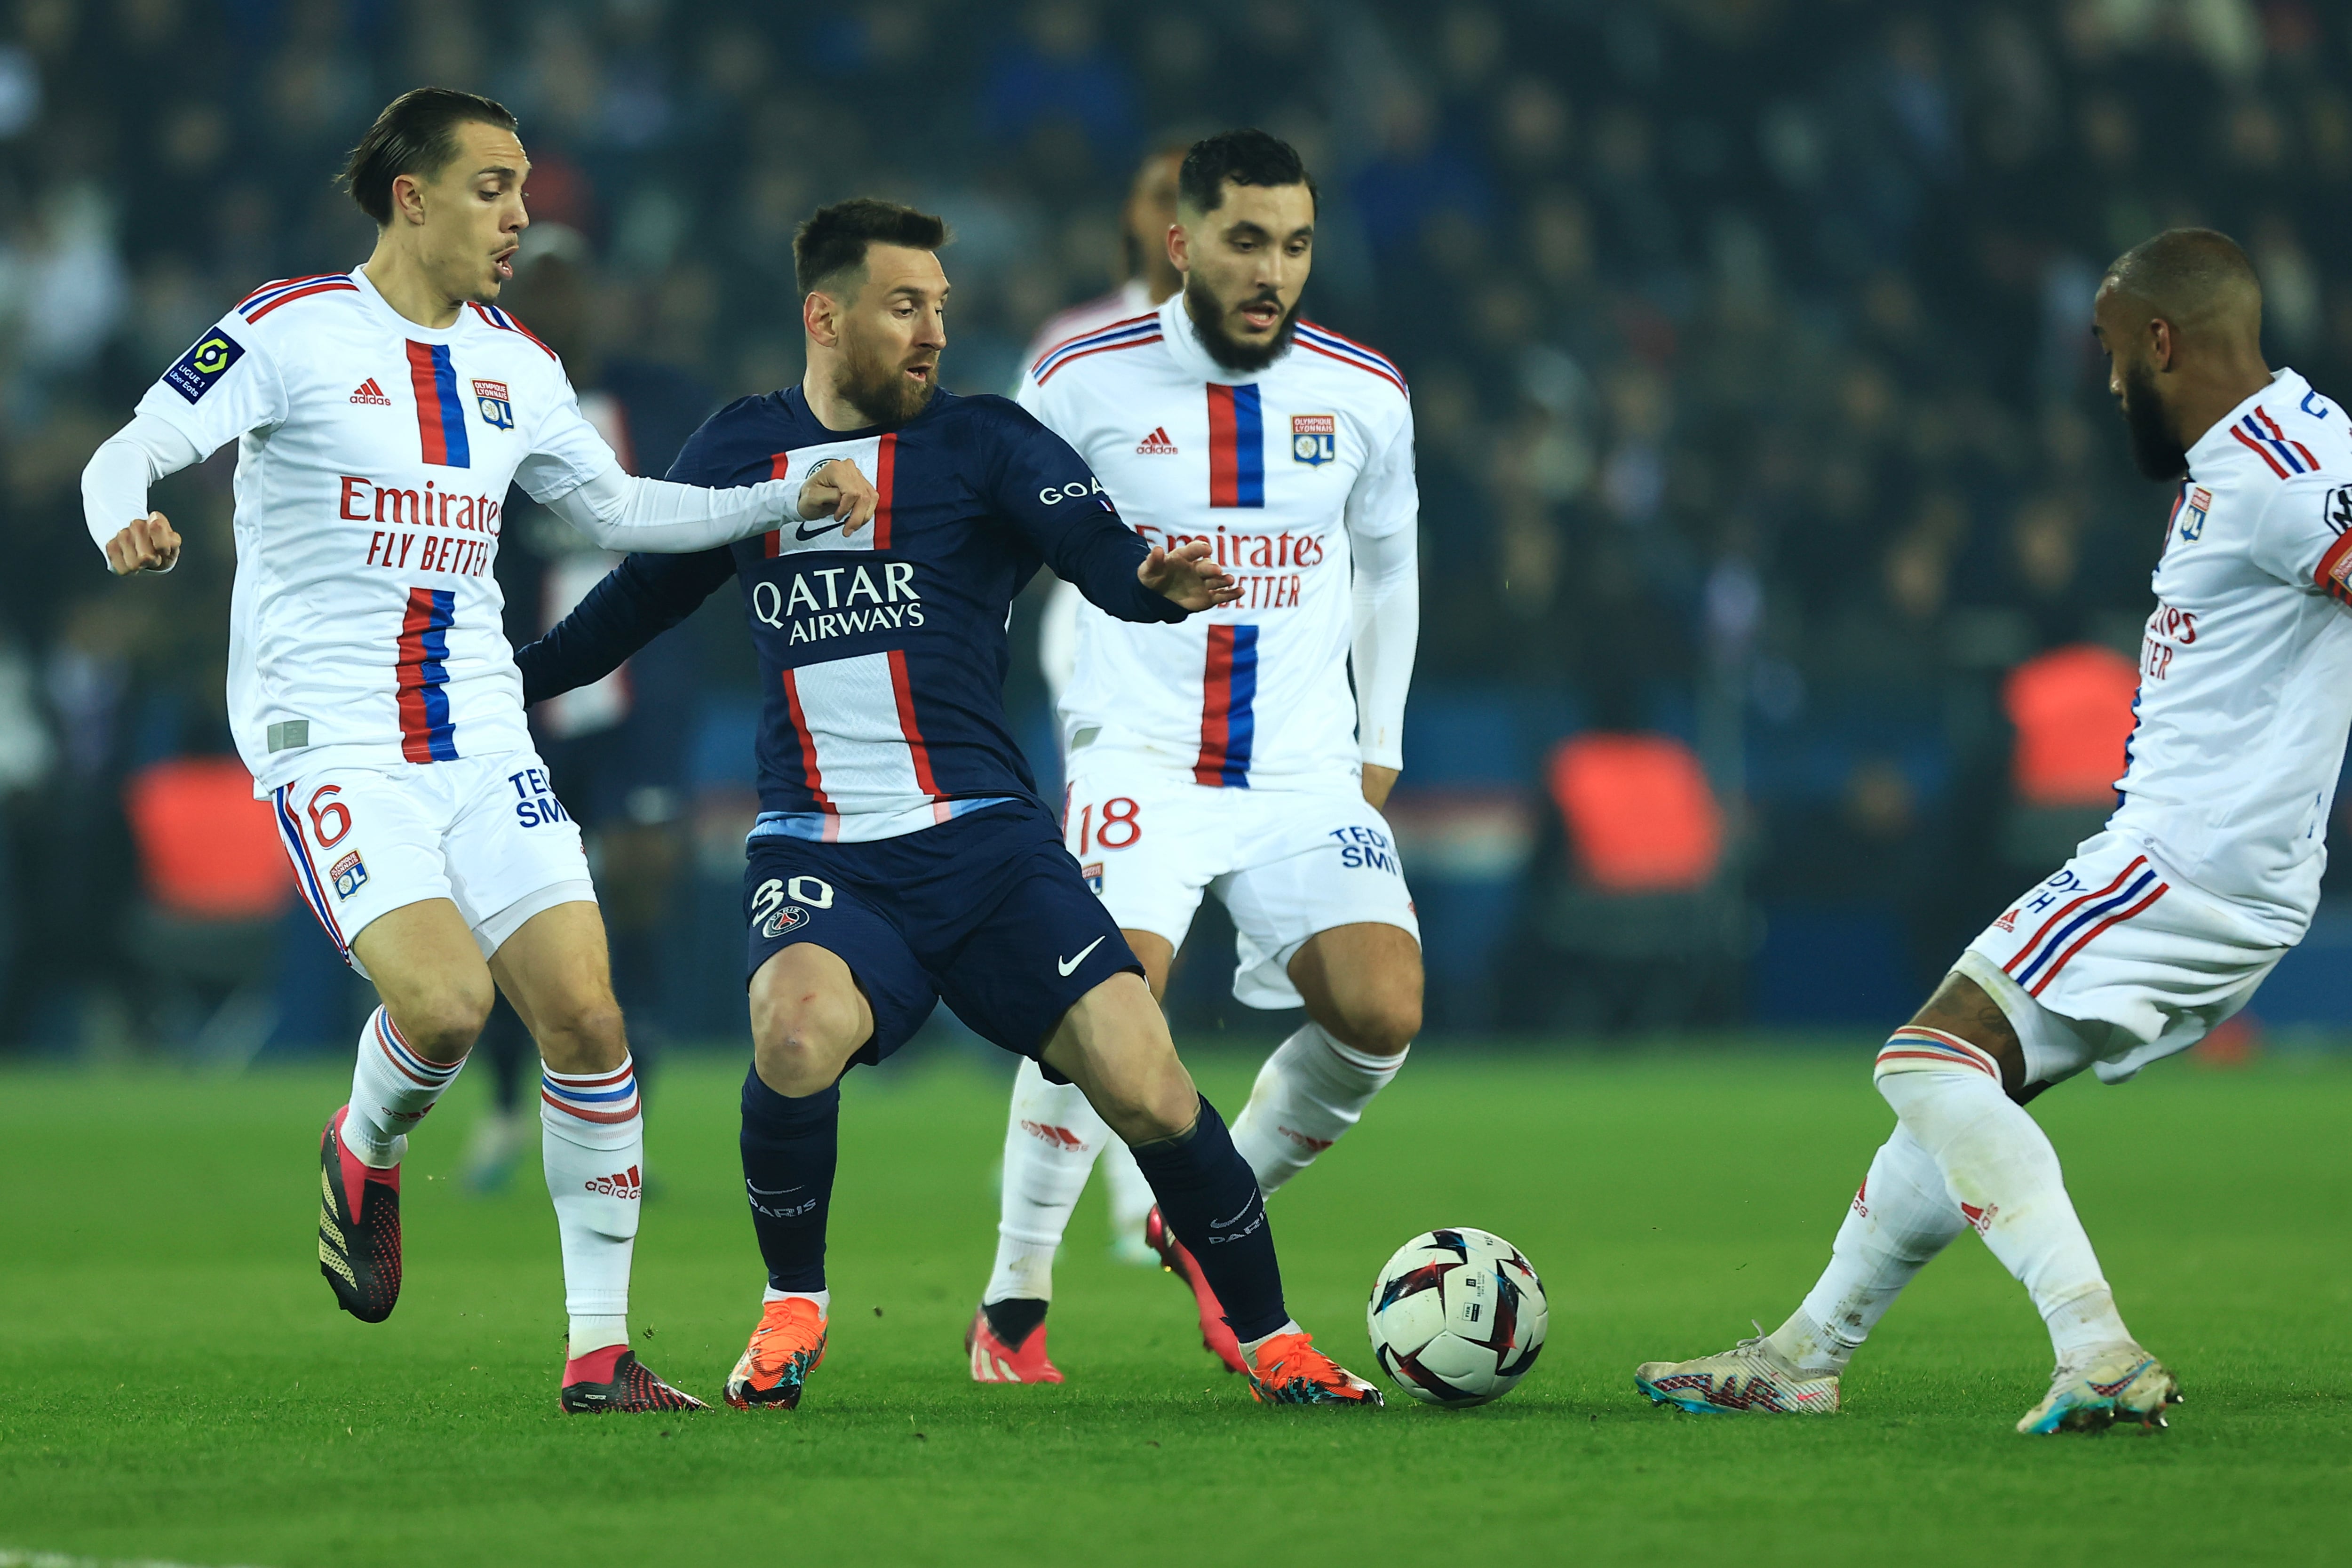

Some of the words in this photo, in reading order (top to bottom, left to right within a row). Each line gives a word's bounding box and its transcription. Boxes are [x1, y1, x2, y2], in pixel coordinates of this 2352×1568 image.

[169, 370, 184, 384] Uber
[182, 381, 199, 397] Eats
[178, 364, 201, 384] LIGUE
[350, 394, 391, 406] adidas
[474, 382, 507, 393] OLYMPIQUE
[477, 389, 508, 399] LYONNAIS
[481, 399, 513, 426] OL
[1295, 417, 1332, 426] OLYMPIQUE
[1136, 444, 1178, 454] adidas
[1295, 435, 1333, 460] OL
[366, 531, 415, 568] FLY
[753, 563, 921, 629] QATAR
[1217, 575, 1301, 609] ETTER
[789, 603, 924, 646] AIRWAYS
[307, 784, 353, 851] 6
[1080, 797, 1142, 857] 18
[331, 852, 356, 876] OLYMPIQUE
[333, 858, 358, 880] LYONNAIS
[339, 867, 366, 894] OL
[752, 876, 834, 928] 30
[748, 1193, 816, 1218] PARIS
